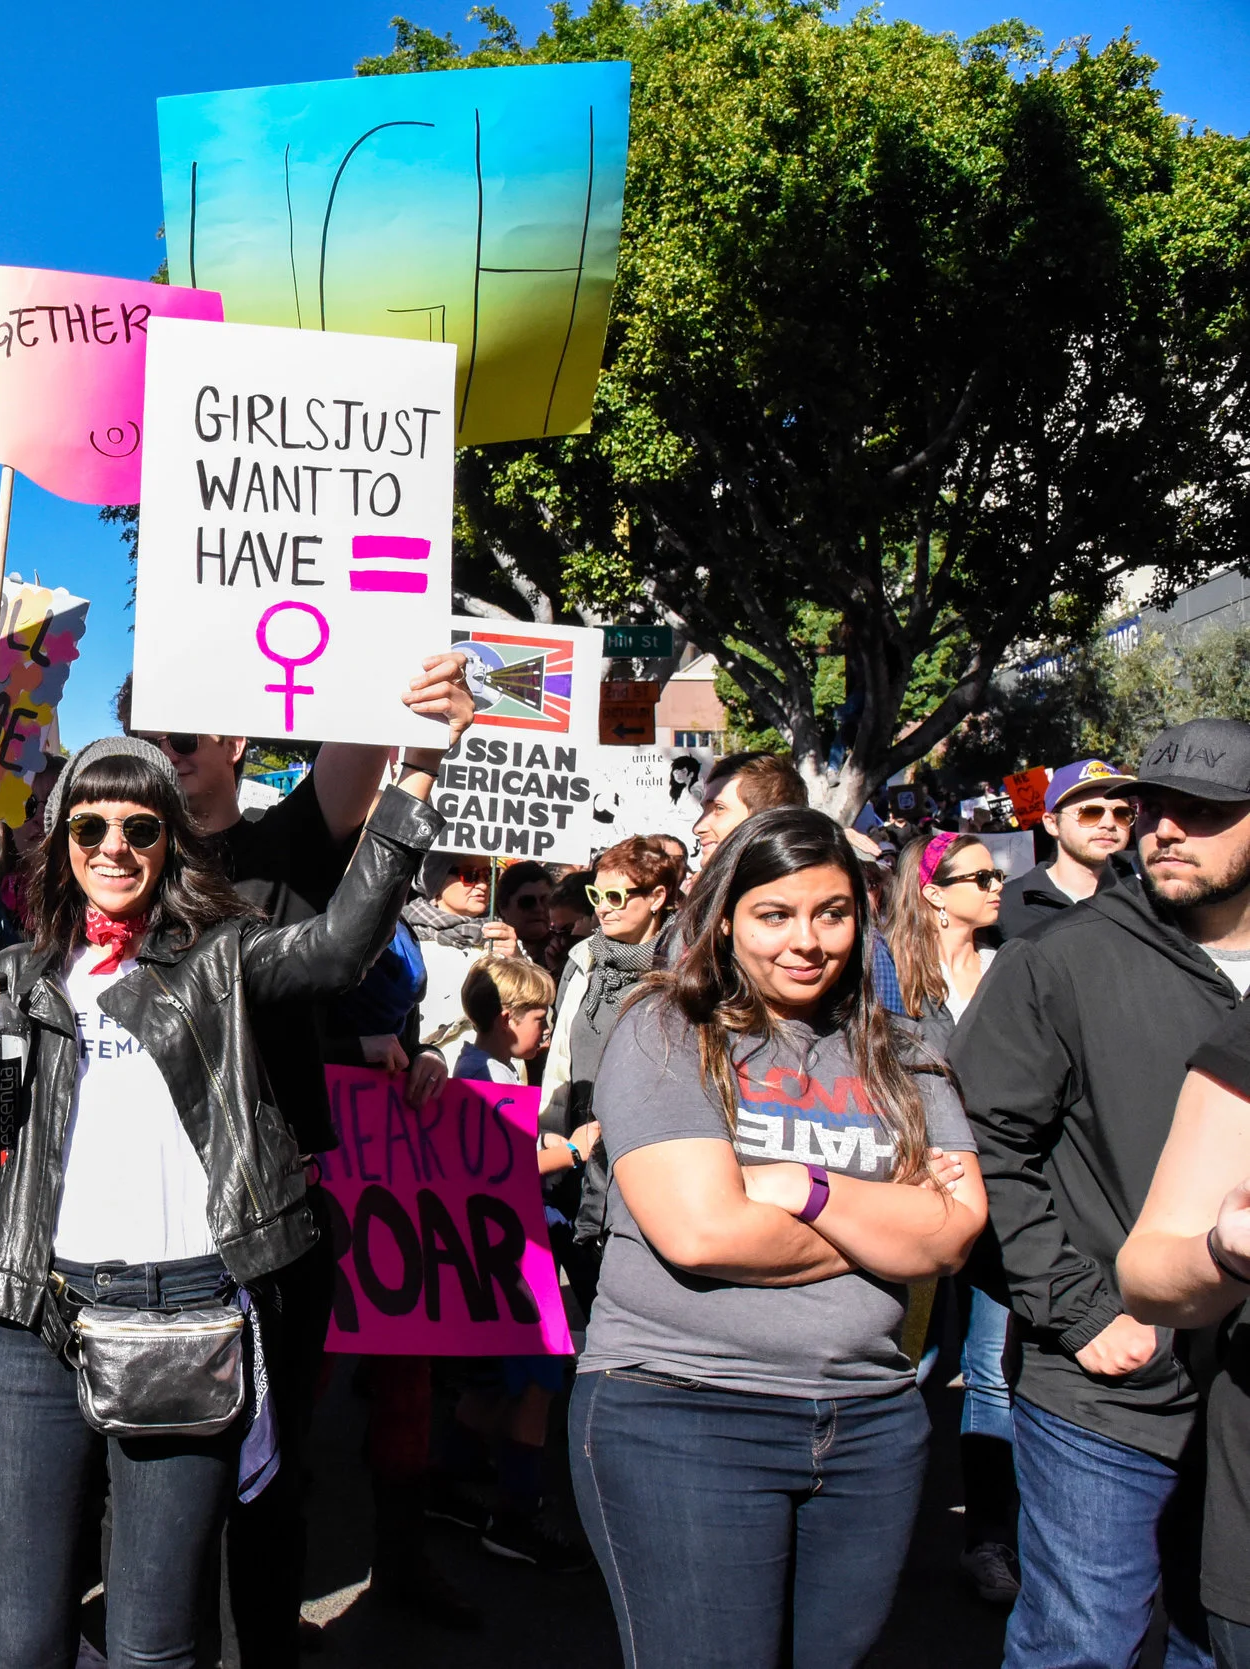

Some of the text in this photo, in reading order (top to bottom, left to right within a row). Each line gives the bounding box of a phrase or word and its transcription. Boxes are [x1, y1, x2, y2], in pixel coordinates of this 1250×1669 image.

[194, 385, 441, 459] GIRLS JUST
[196, 457, 402, 517] WANT TO
[196, 526, 325, 588] HAVE
[607, 634, 659, 648] Hill St
[429, 792, 574, 829] GAINST
[437, 822, 555, 856] TRUMP
[458, 1097, 515, 1184] US
[734, 1107, 898, 1172] HATE
